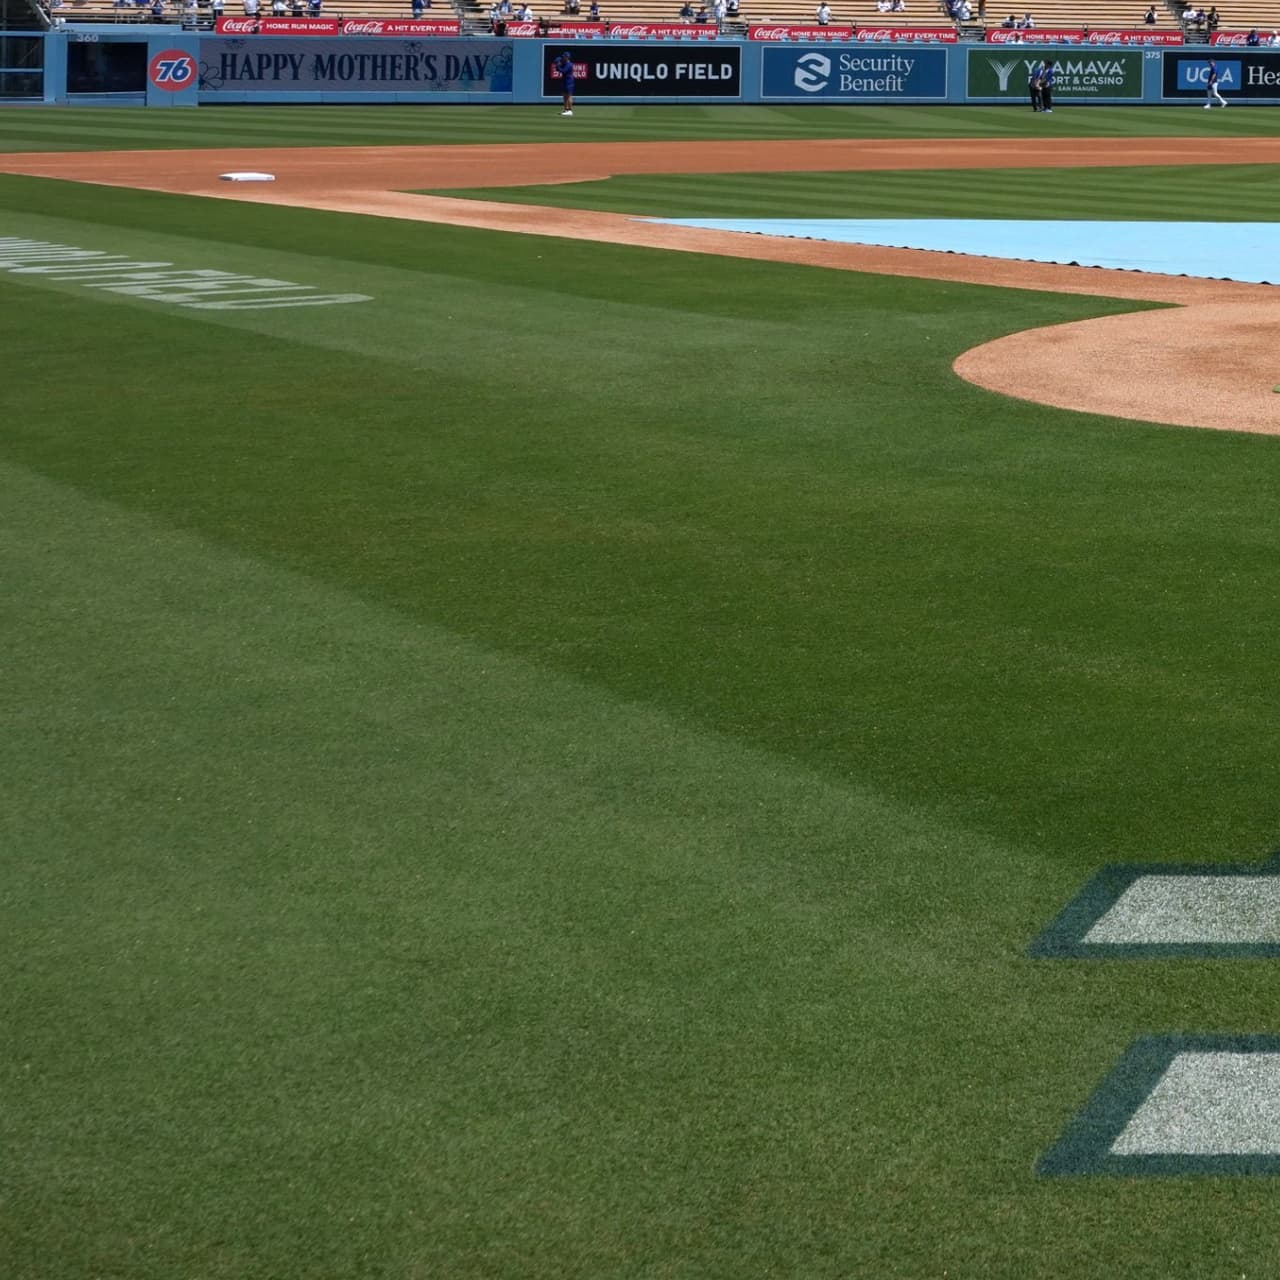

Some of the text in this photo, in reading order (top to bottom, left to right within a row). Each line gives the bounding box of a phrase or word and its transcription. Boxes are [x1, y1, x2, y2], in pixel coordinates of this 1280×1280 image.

[265, 22, 335, 31] HOME RUN MAGIC
[343, 20, 384, 35] Coca-Cola
[395, 24, 409, 33] HIT
[411, 24, 436, 33] EVERY
[437, 24, 459, 33] TIME
[839, 53, 916, 76] Security
[1144, 51, 1161, 60] 375
[155, 57, 192, 82] 76
[218, 52, 492, 82] HAPPY MOTHER'S DAY
[595, 63, 734, 82] UNIQLO FIELD
[1185, 66, 1235, 84] UCA
[839, 74, 907, 92] Benefit
[1072, 76, 1081, 85] &
[1083, 76, 1124, 86] CASINO
